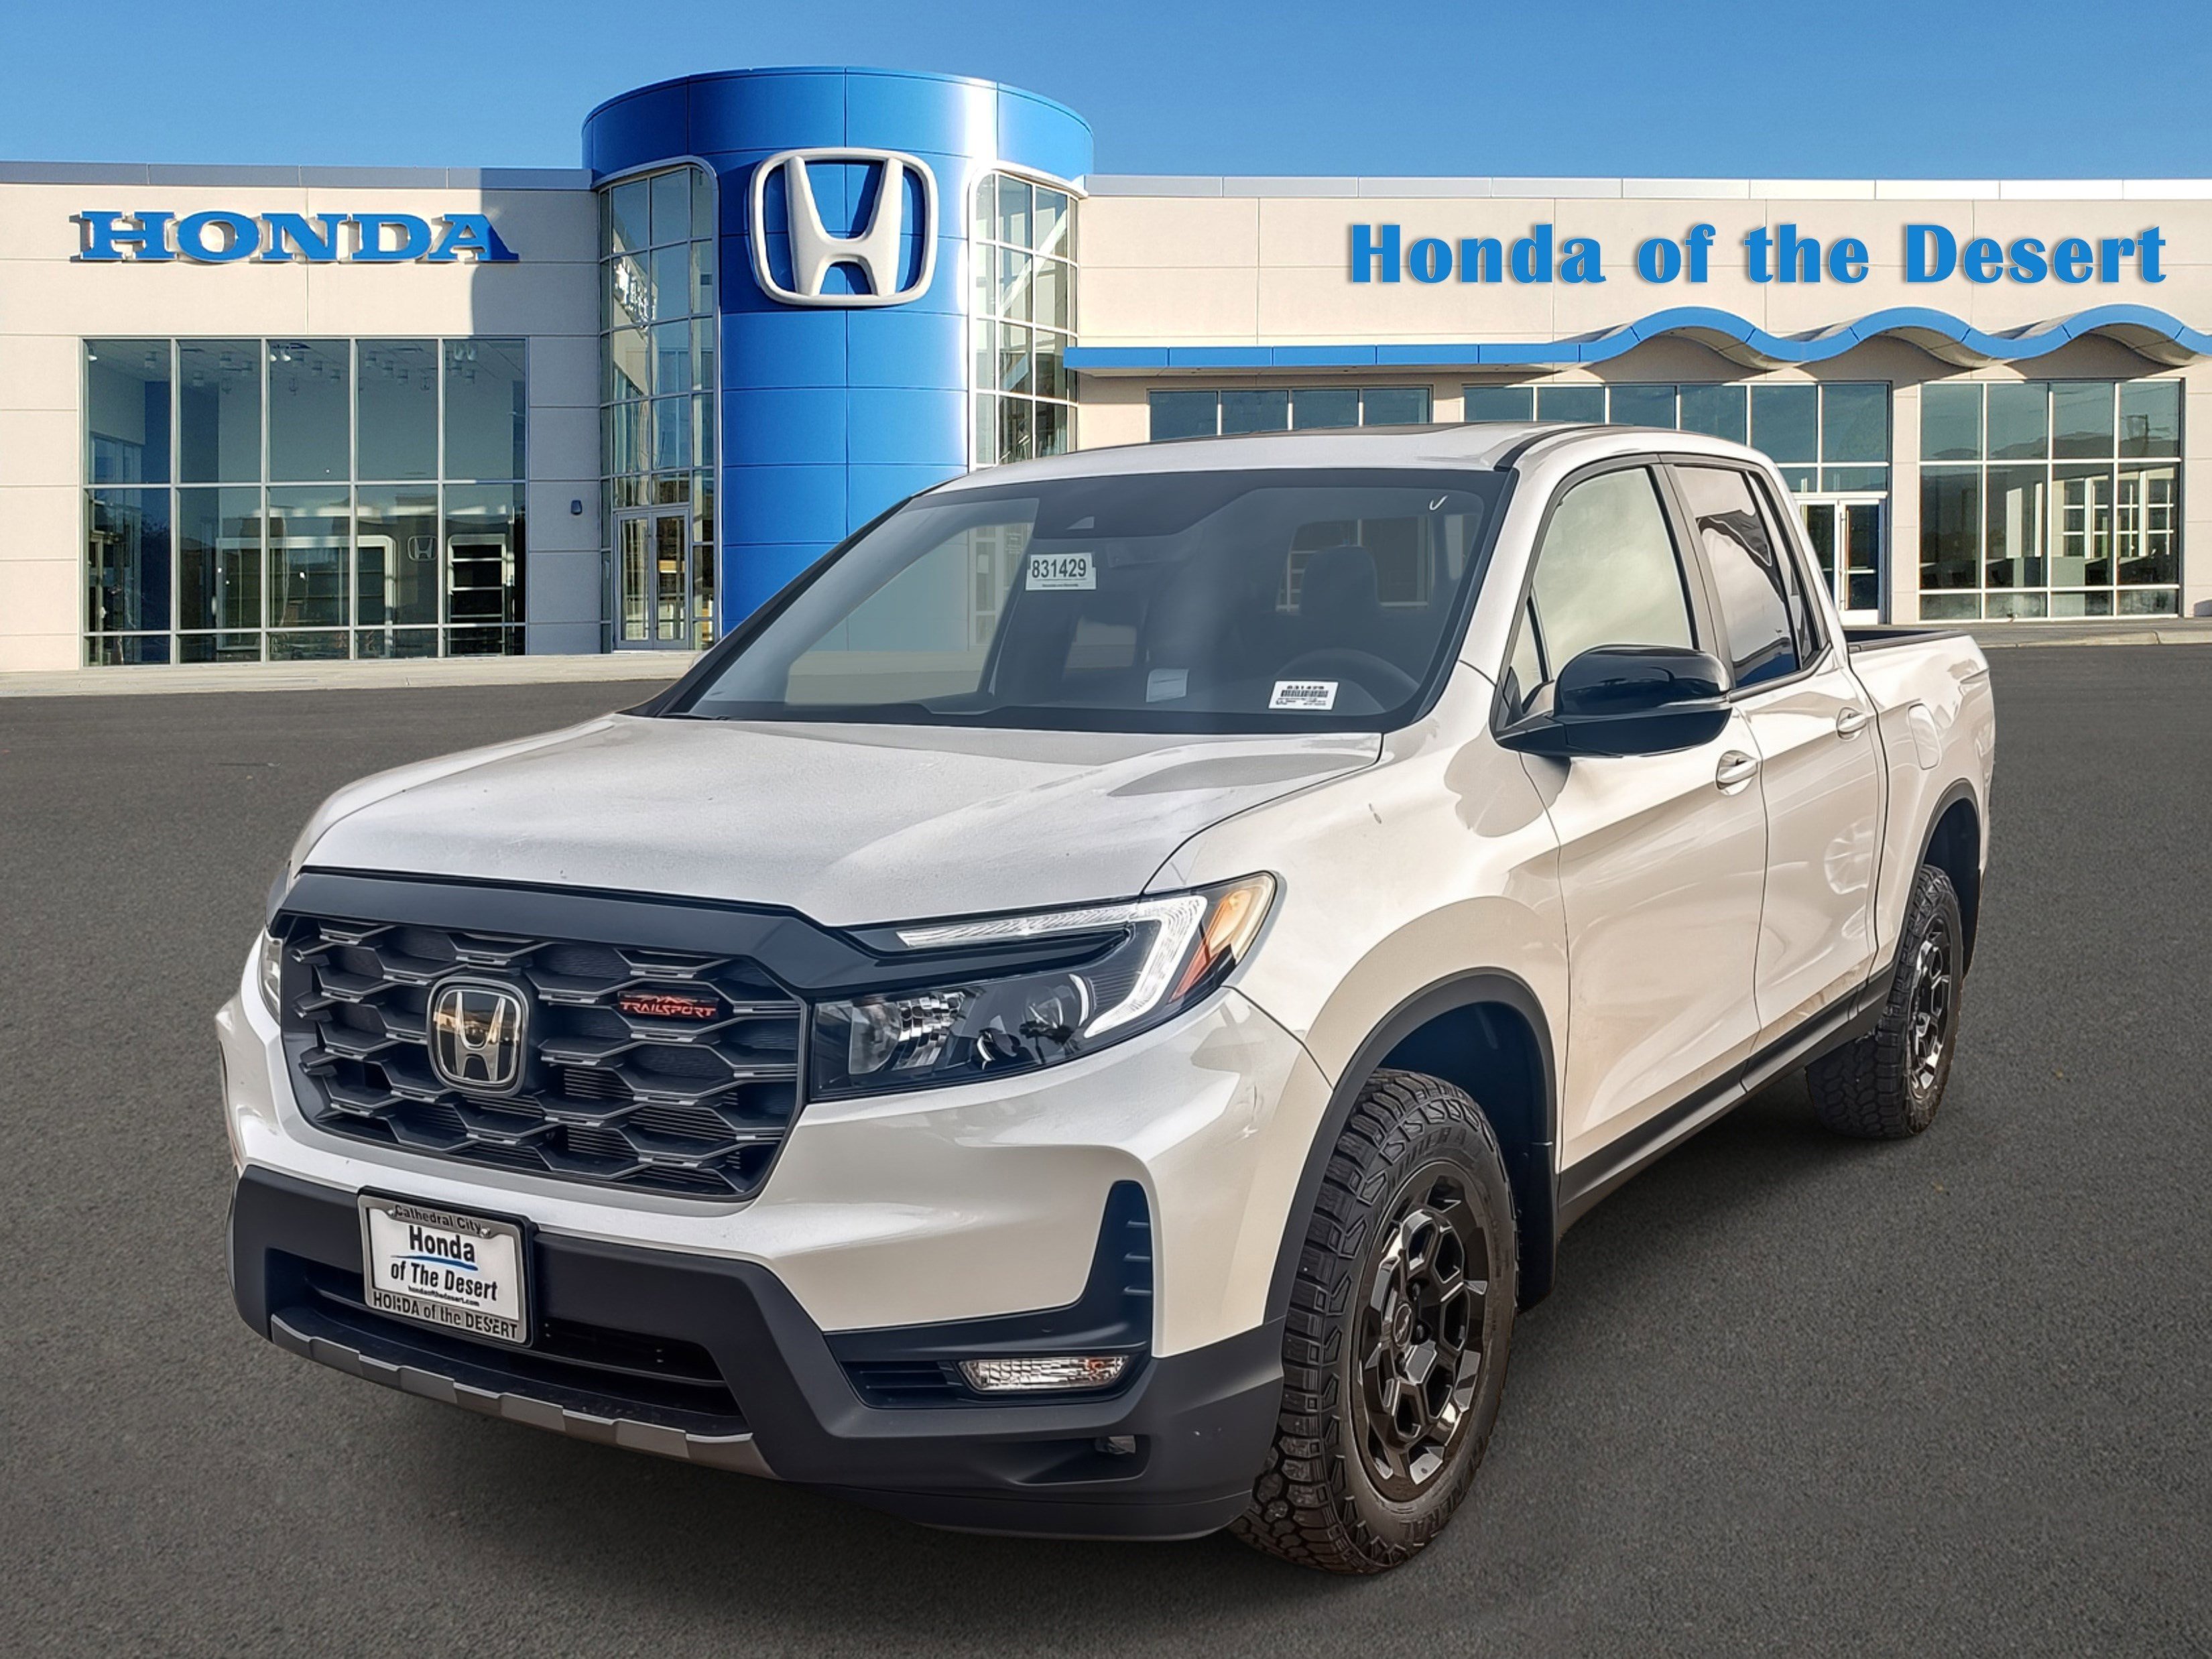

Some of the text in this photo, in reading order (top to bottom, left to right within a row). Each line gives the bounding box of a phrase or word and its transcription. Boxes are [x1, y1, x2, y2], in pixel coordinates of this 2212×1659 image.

[70, 210, 519, 263] HONDA
[1351, 223, 2168, 284] Honda of the Desert
[1032, 558, 1087, 578] 831429
[619, 1001, 717, 1018] TRAILSPORT
[394, 1205, 482, 1235] Cathedral City
[408, 1225, 475, 1263] Honda
[391, 1261, 498, 1302] of The Desert
[373, 1291, 518, 1339] HONDA of the DESERT
